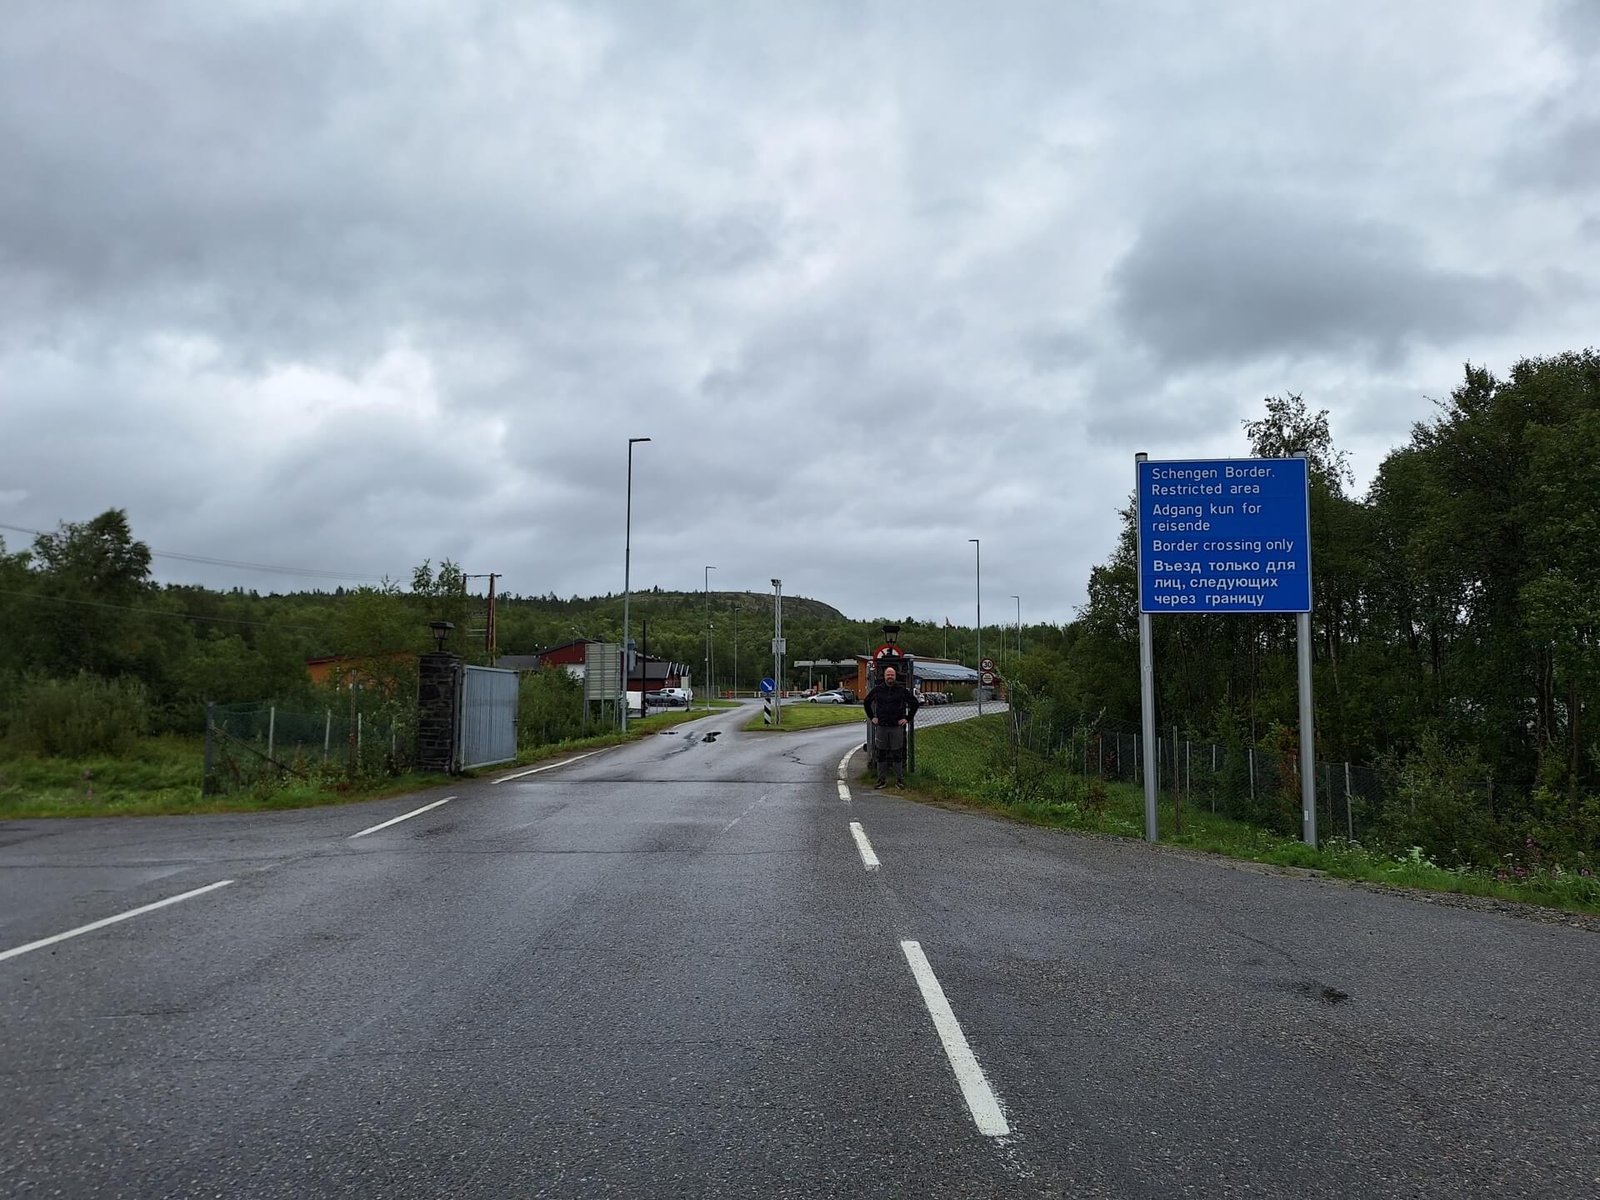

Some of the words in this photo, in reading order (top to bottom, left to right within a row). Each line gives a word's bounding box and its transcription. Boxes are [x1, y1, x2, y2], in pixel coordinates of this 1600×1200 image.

[1152, 469, 1217, 481] Schengen
[1226, 467, 1275, 478] Border.
[1152, 484, 1222, 495] Restricted
[1230, 485, 1260, 494] area
[1153, 504, 1202, 517] Adgang
[1211, 504, 1234, 514] kun
[1242, 503, 1261, 514] for
[1153, 521, 1210, 532] reisende
[1154, 541, 1199, 552] Border
[1203, 541, 1261, 552] crossing
[1266, 539, 1293, 552] only
[1154, 560, 1201, 573] Въезд
[1209, 561, 1259, 571] только
[1266, 561, 1295, 573] для
[1154, 578, 1186, 590] лиц,
[1190, 577, 1278, 590] следующих
[1155, 595, 1196, 606] через
[1206, 594, 1264, 606] границу
